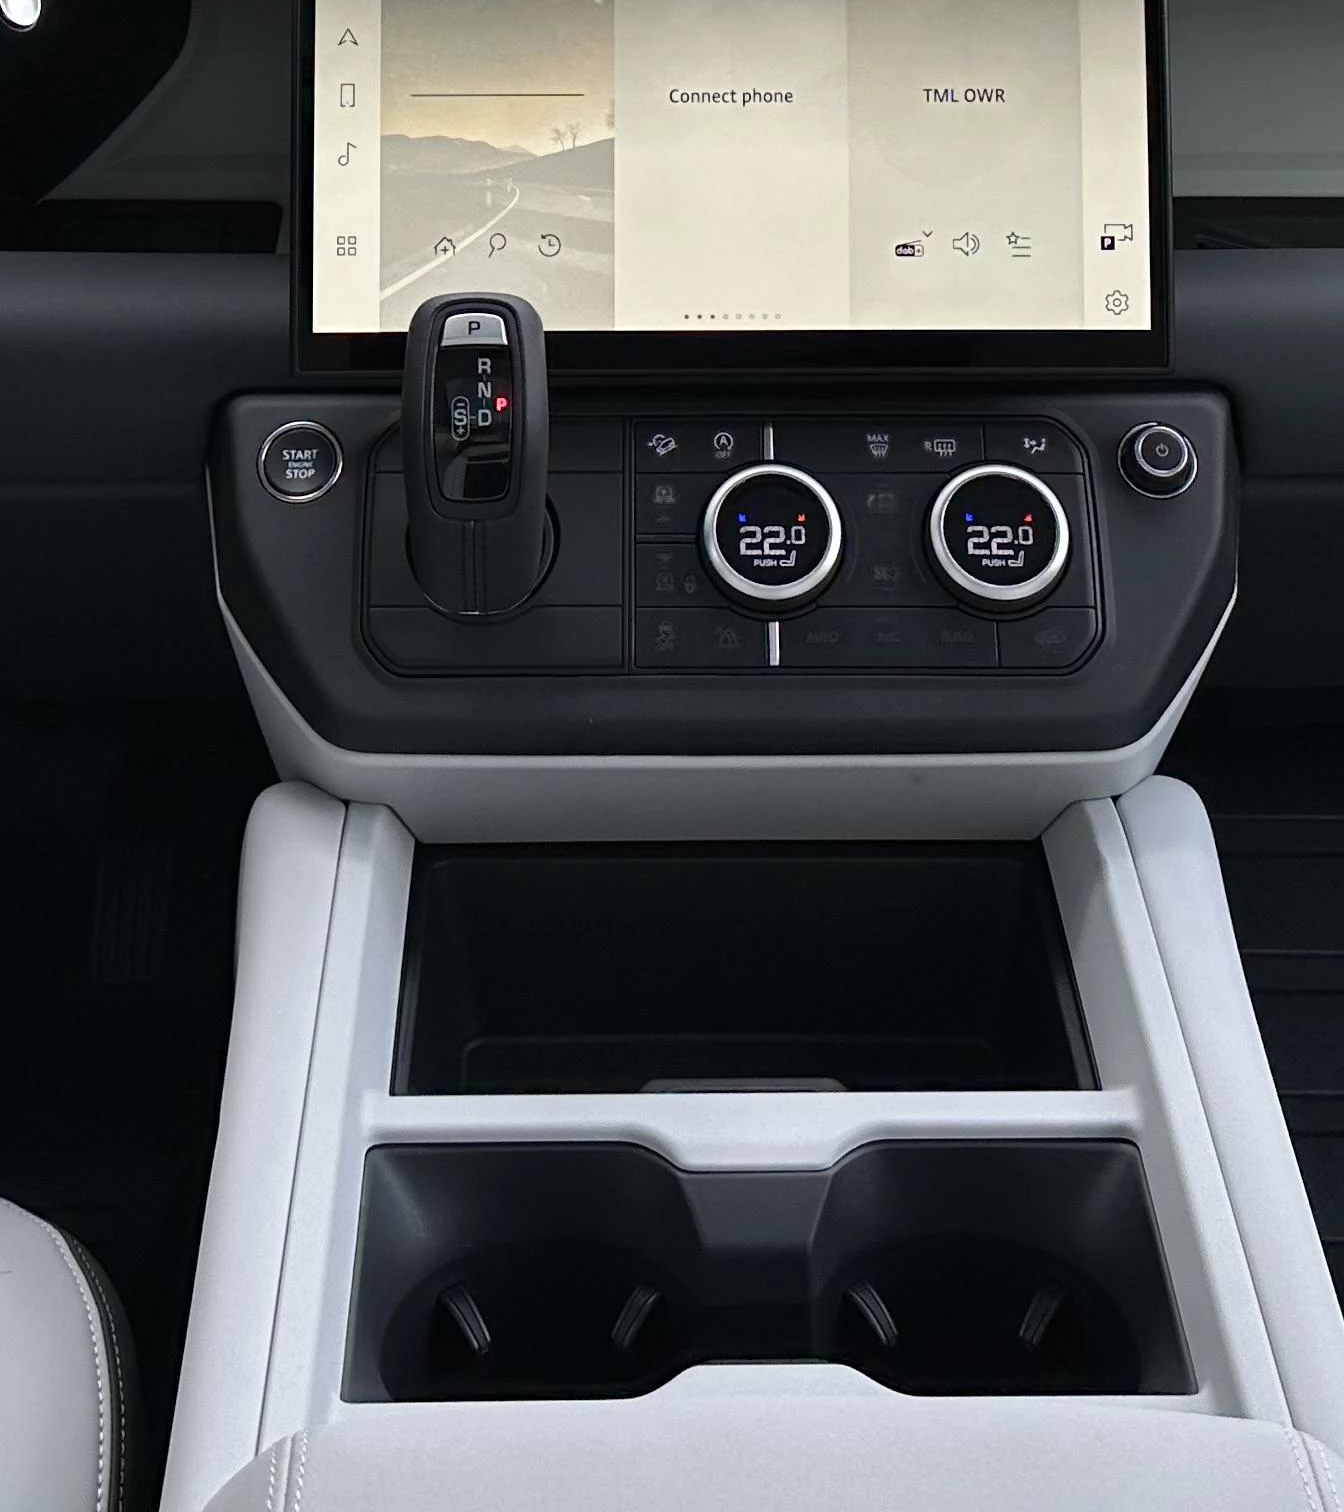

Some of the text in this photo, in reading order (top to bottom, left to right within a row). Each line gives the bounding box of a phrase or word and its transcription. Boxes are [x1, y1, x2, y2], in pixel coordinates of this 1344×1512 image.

[668, 88, 794, 107] Connect phone
[922, 88, 1006, 103] TML OWR
[468, 321, 481, 335] P
[477, 358, 491, 374] R
[477, 381, 491, 398] N
[454, 409, 467, 426] S
[477, 409, 492, 426] D
[867, 434, 889, 442] MAX
[282, 449, 318, 460] START
[285, 469, 315, 479] STOP
[739, 526, 806, 555] 22.0
[967, 526, 1034, 555] 22.0
[754, 558, 777, 567] PUSH
[982, 558, 1006, 567] PUSH
